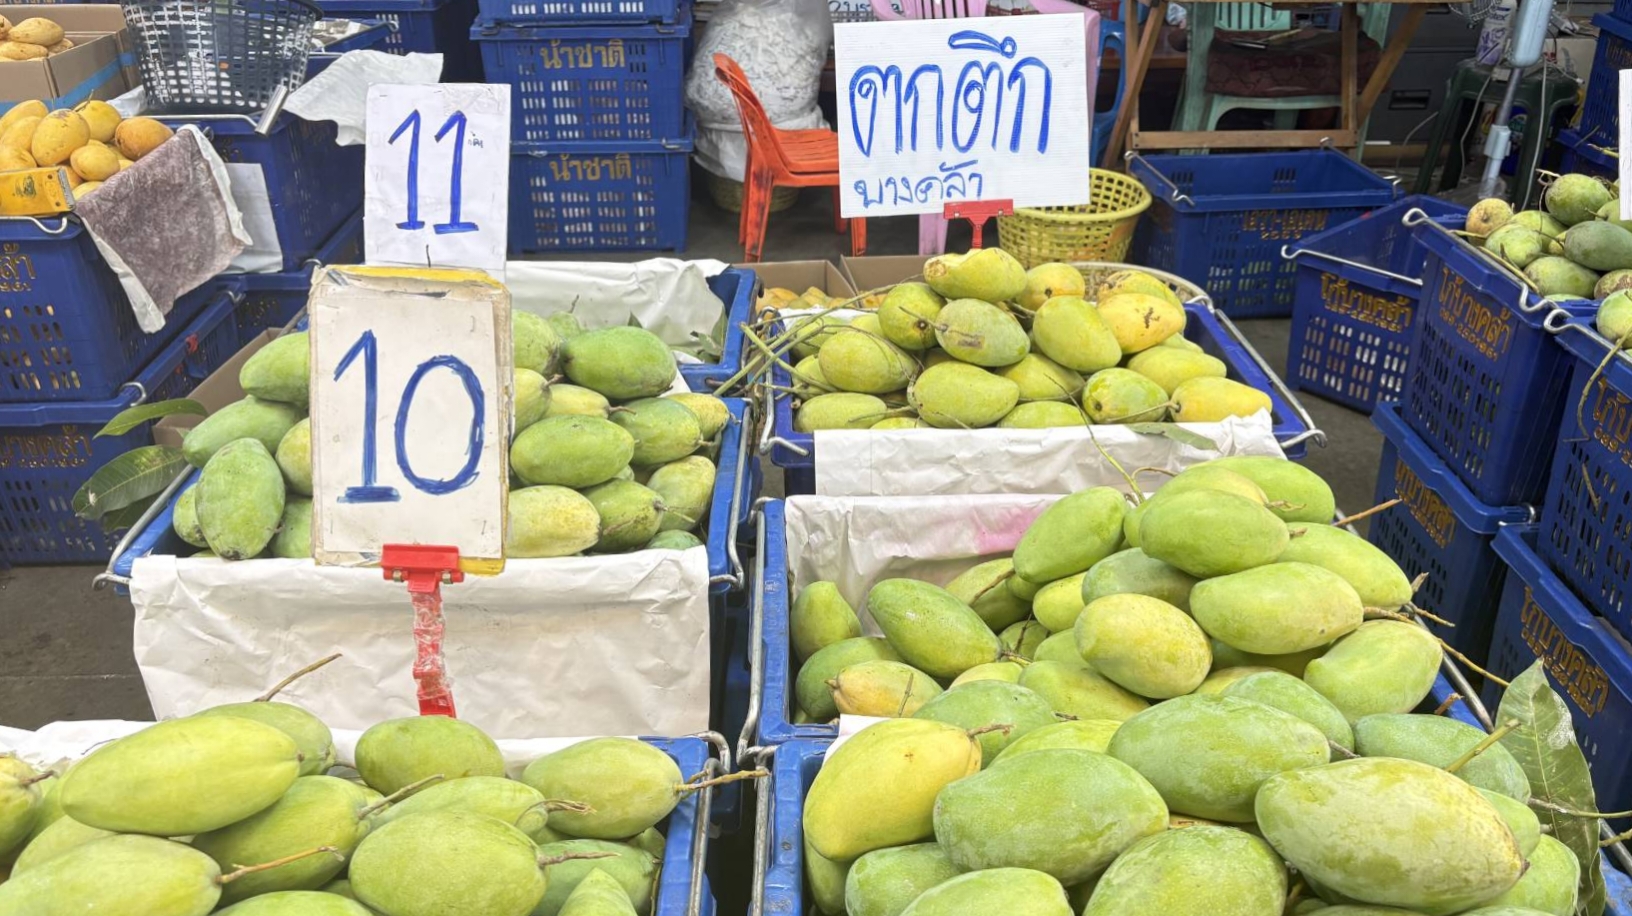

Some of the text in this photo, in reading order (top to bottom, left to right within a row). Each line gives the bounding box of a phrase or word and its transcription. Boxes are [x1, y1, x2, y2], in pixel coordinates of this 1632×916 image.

[849, 30, 1052, 157] ตกตึก
[388, 109, 479, 234] 11
[853, 159, 983, 208] บางคล้า
[334, 329, 486, 503] 10
